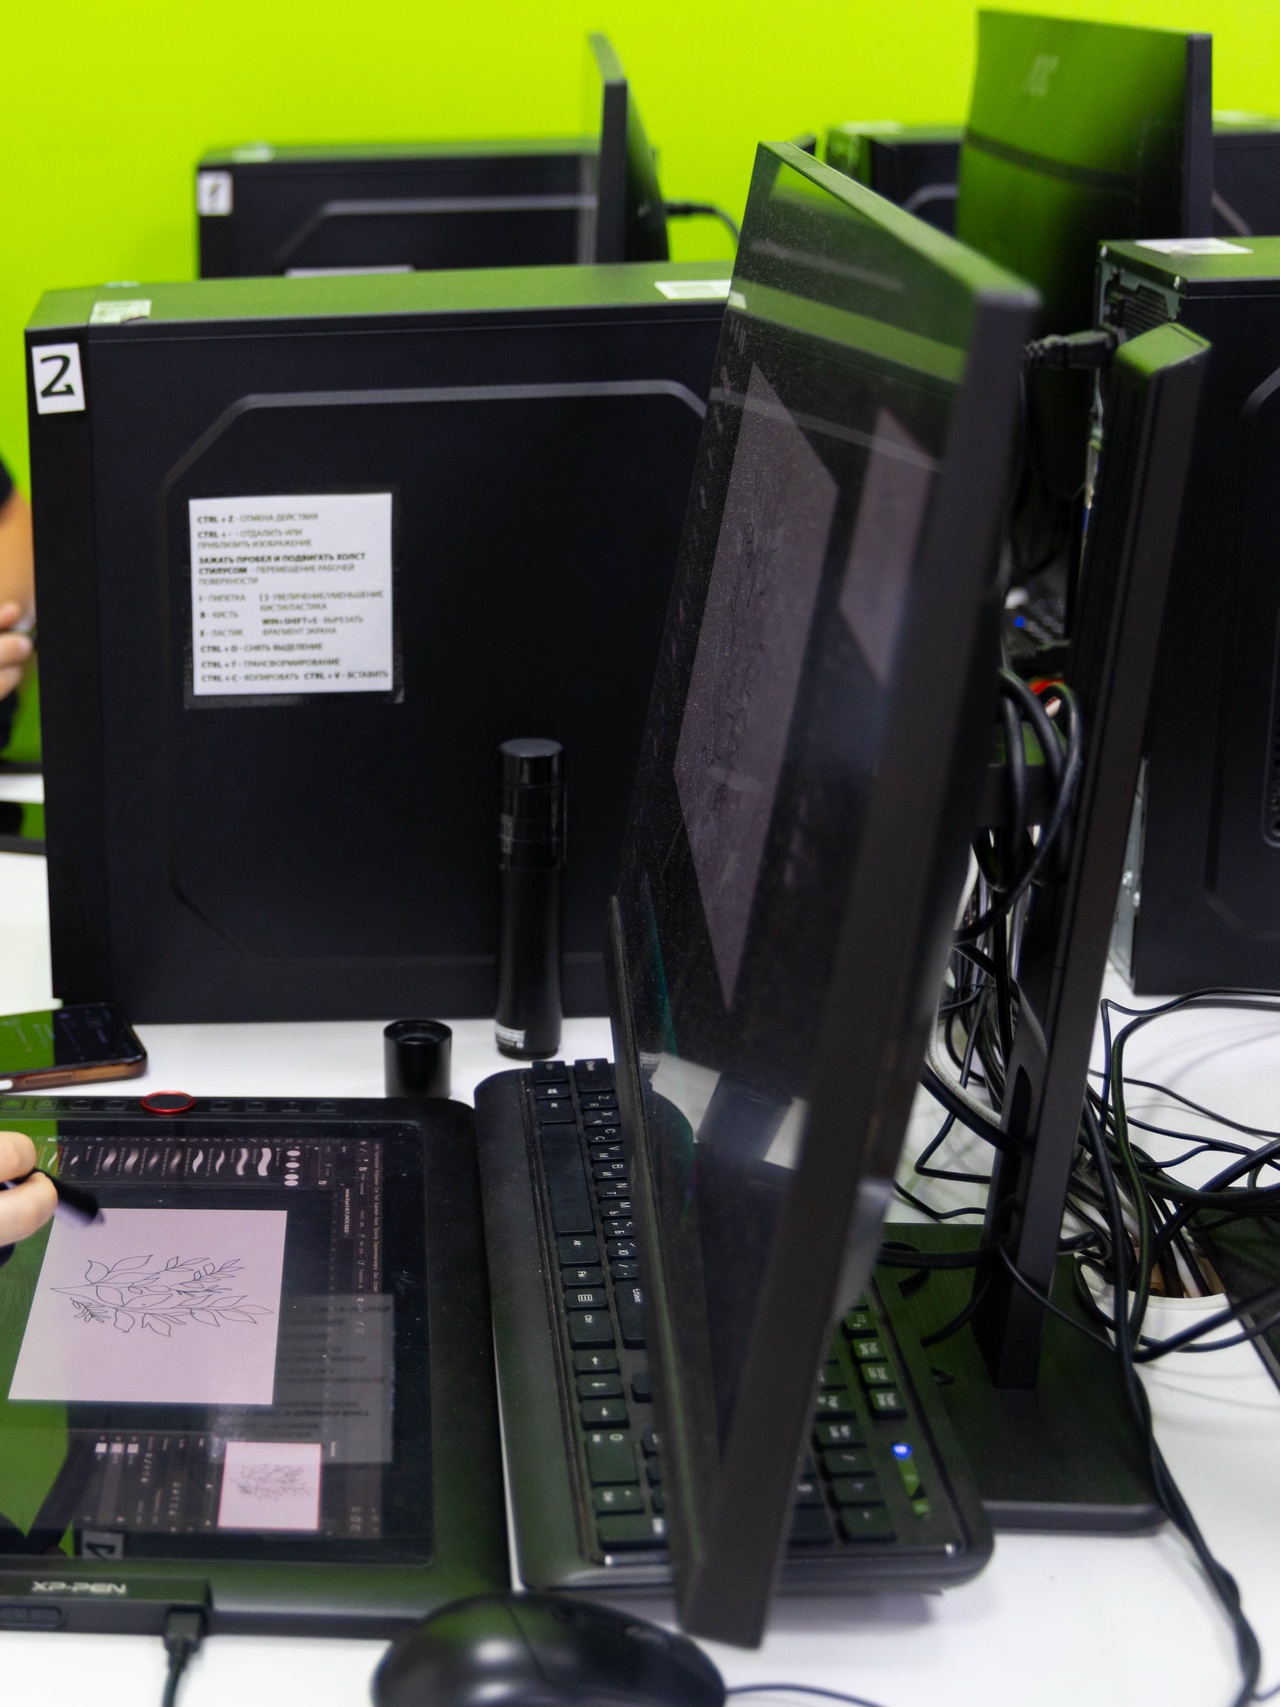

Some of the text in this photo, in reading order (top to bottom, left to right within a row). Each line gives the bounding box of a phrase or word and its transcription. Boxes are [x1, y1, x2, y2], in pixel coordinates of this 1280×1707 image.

[40, 354, 75, 399] 2
[197, 516, 218, 524] CTRL
[228, 515, 234, 523] Z
[240, 514, 273, 522] ОТМЕНА
[276, 512, 318, 522] ДЕЙСТВИЯ
[198, 531, 218, 539] CTRL
[240, 530, 282, 538] ОТДАЛИТЬ
[198, 539, 312, 550] ПРИБЛИЗИТЬ ИЗОБРАЖЕНИЕ
[199, 556, 234, 564] ЗАЖАТЬ
[282, 554, 334, 562] ПОДВИГАТЬ
[336, 552, 366, 560] ХОЛСТ
[198, 567, 248, 576] СТИЛУСОМ
[256, 564, 316, 574] ПЕРЕМЕЩЕНИЕ
[318, 563, 355, 572] РАБОЧЕЙ
[198, 577, 258, 586] ПОВЕРХНОСТИ
[208, 594, 246, 602] ПИПЕТКА
[324, 616, 364, 624] ВЫРЕЗАТЬ
[262, 628, 304, 636] ФРАГМЕНТ
[272, 643, 322, 652] ВЫДЕЛЕНИЕ
[244, 674, 298, 682] КОПИРОВАТЬ
[304, 672, 325, 680] CTRL
[346, 670, 388, 679] ВСТАВИТЬ
[578, 1270, 586, 1278] Fn
[32, 1580, 127, 1594] XP-PEN
